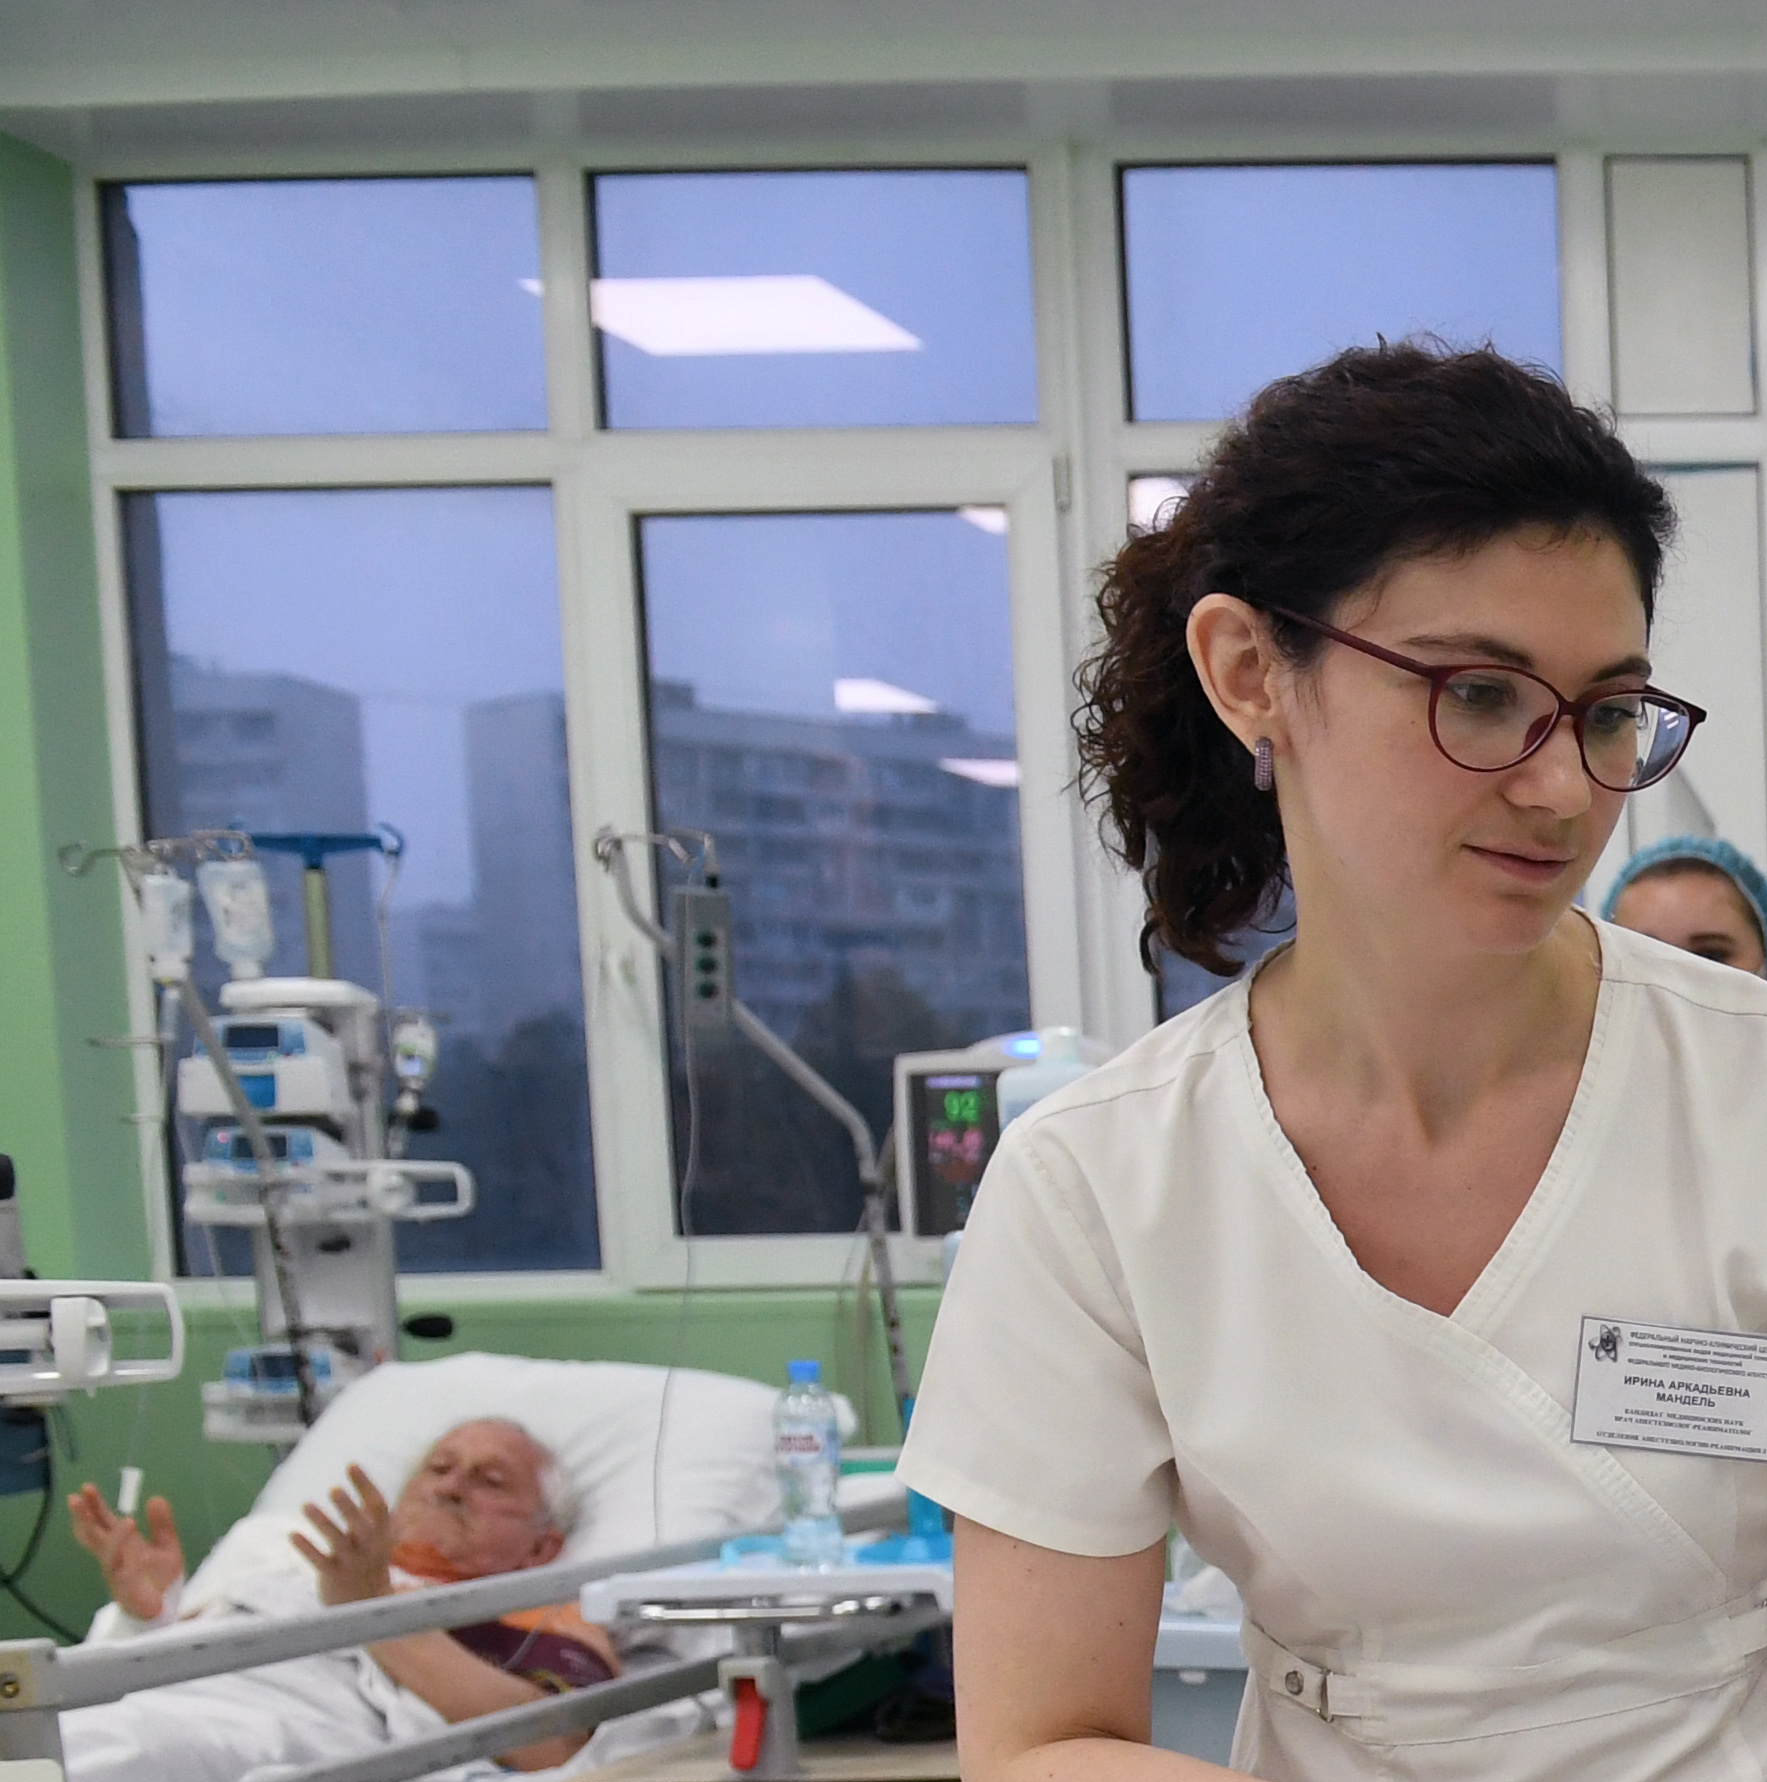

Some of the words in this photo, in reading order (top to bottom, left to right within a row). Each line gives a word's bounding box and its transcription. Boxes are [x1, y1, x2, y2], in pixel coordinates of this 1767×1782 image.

[1624, 1375, 1665, 1389] ИРИНА
[1668, 1380, 1750, 1398] АРКАДЬЕВНА
[1656, 1392, 1716, 1408] МАНДЕЛЬ
[1614, 1416, 1634, 1424] ВРАЧ
